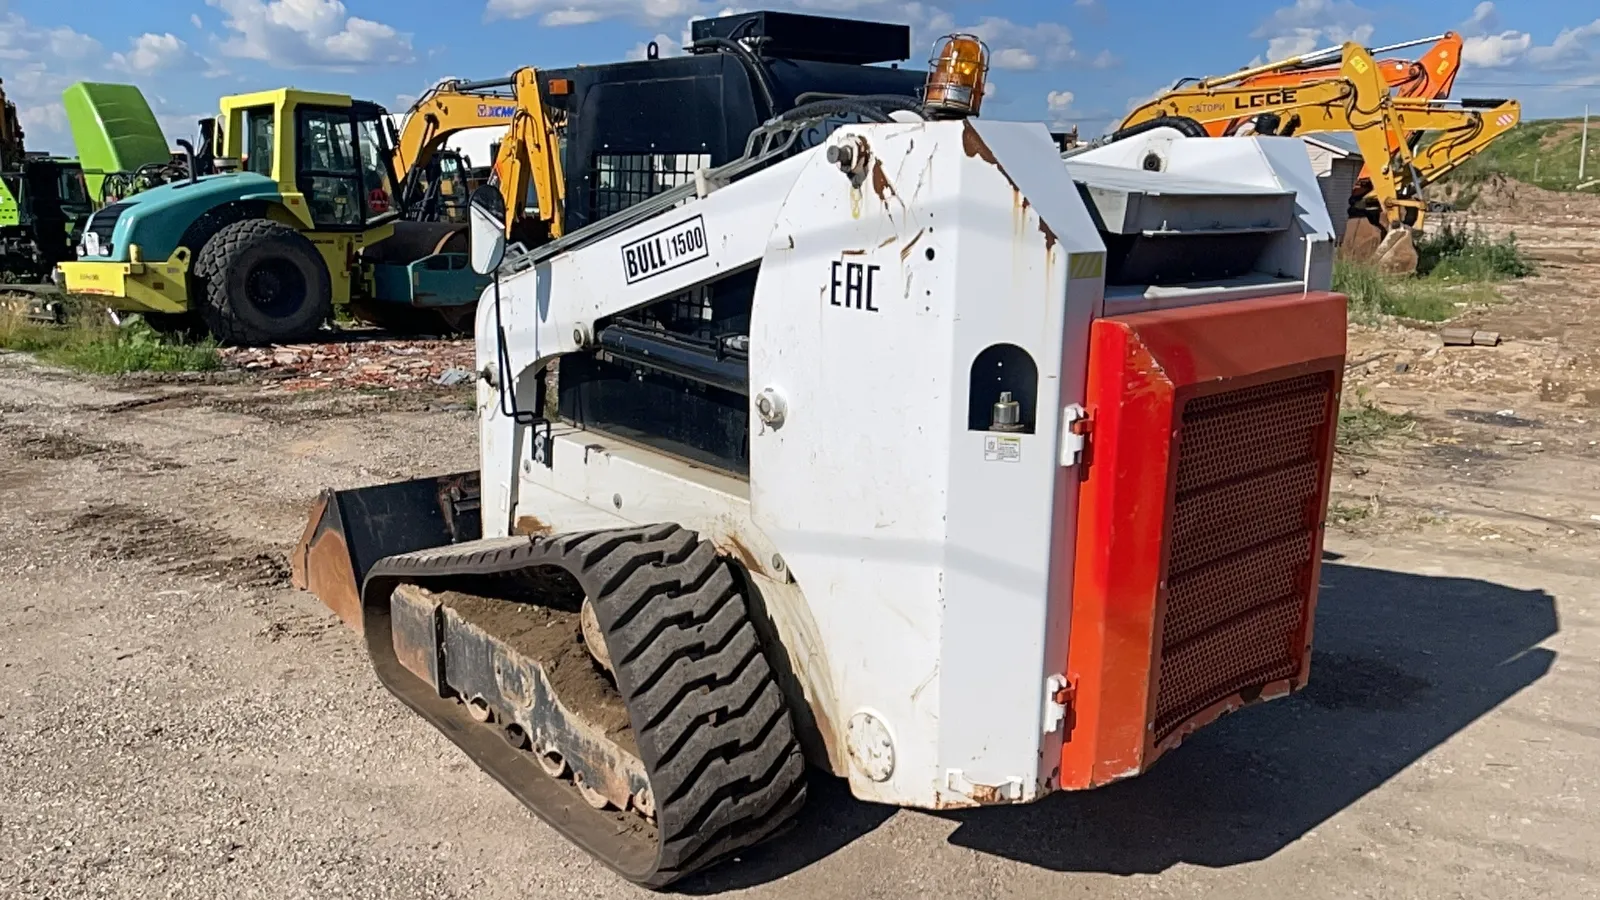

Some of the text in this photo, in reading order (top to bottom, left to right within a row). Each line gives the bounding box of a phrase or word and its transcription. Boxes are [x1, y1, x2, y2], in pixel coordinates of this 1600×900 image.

[487, 105, 516, 118] XCM
[1234, 89, 1298, 109] LGCE
[625, 226, 703, 278] BULL 1500
[830, 260, 881, 313] EAC
